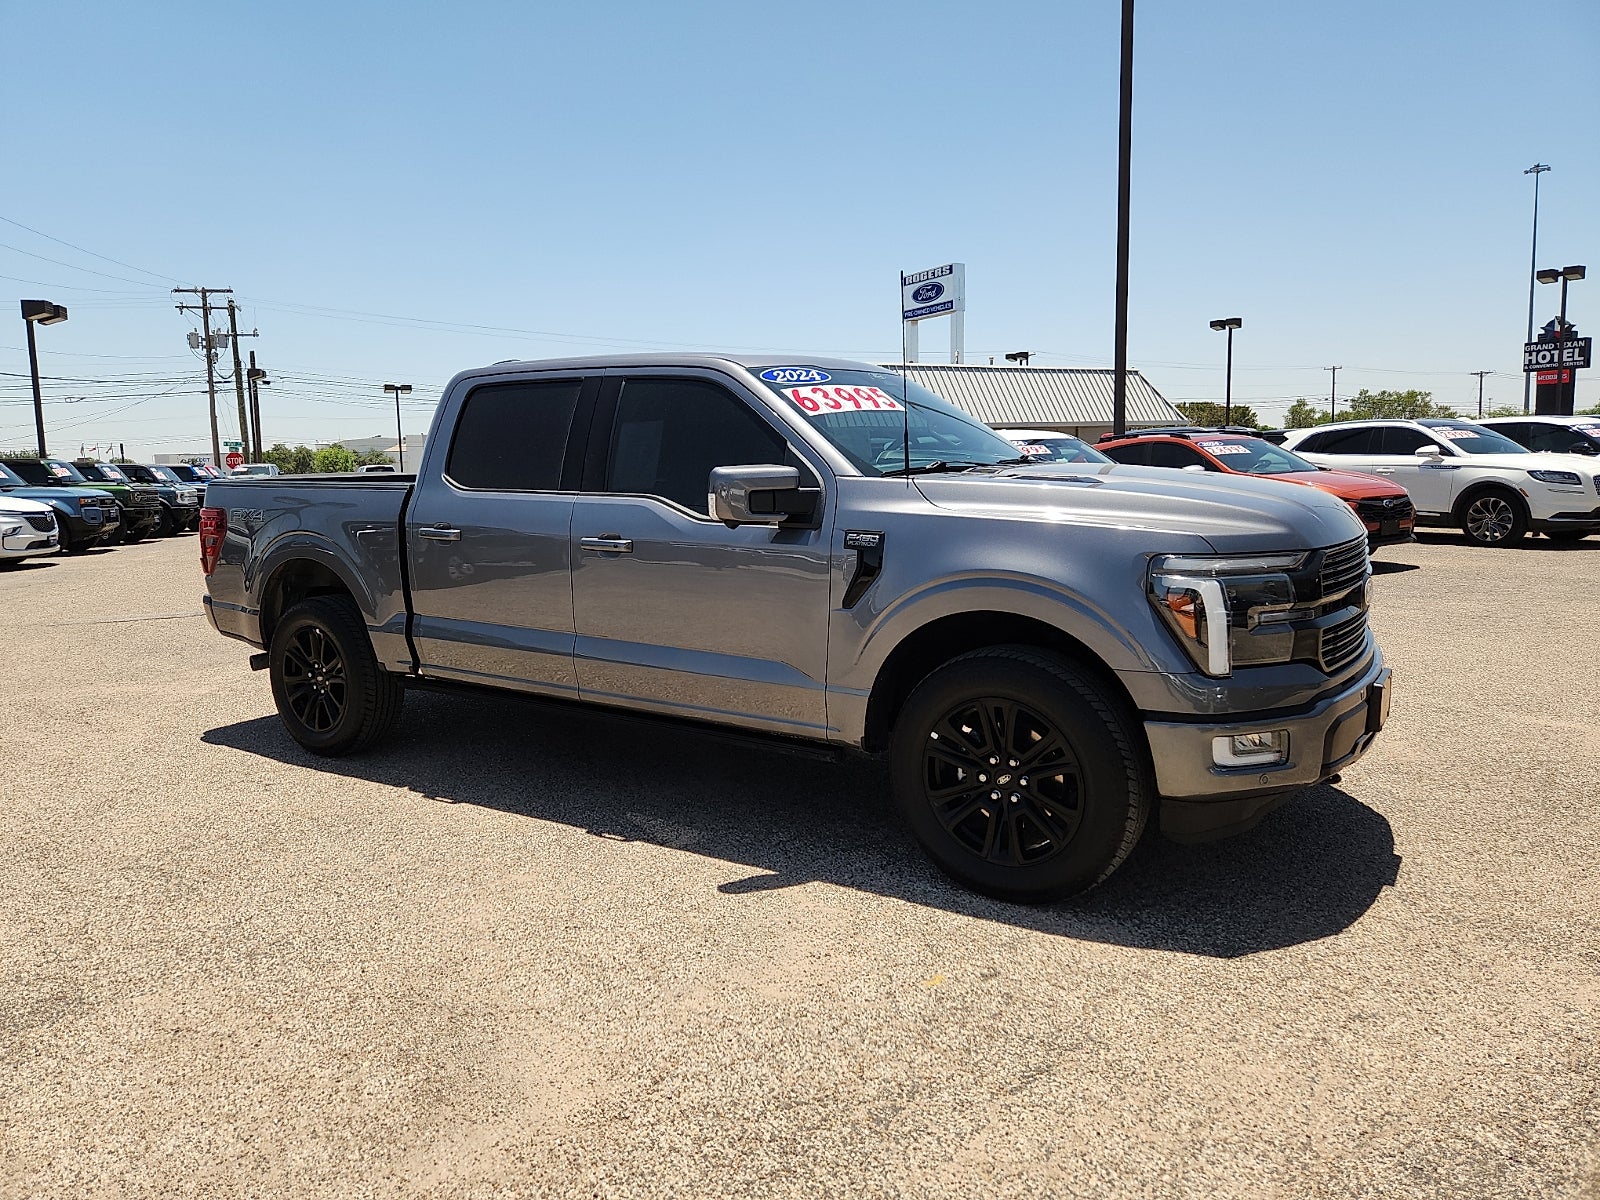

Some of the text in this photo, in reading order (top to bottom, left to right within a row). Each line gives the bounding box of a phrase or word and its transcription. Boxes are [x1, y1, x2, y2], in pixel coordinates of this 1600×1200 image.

[905, 265, 950, 285] ROGERS
[918, 285, 937, 300] Ford
[904, 302, 952, 318] PRE-OWNED VEHICLES
[1525, 343, 1555, 351] GRAND
[1524, 348, 1585, 364] HOTEL
[773, 370, 822, 382] 2024
[791, 387, 897, 412] 63995
[226, 457, 243, 465] STOP
[229, 508, 265, 522] FX4
